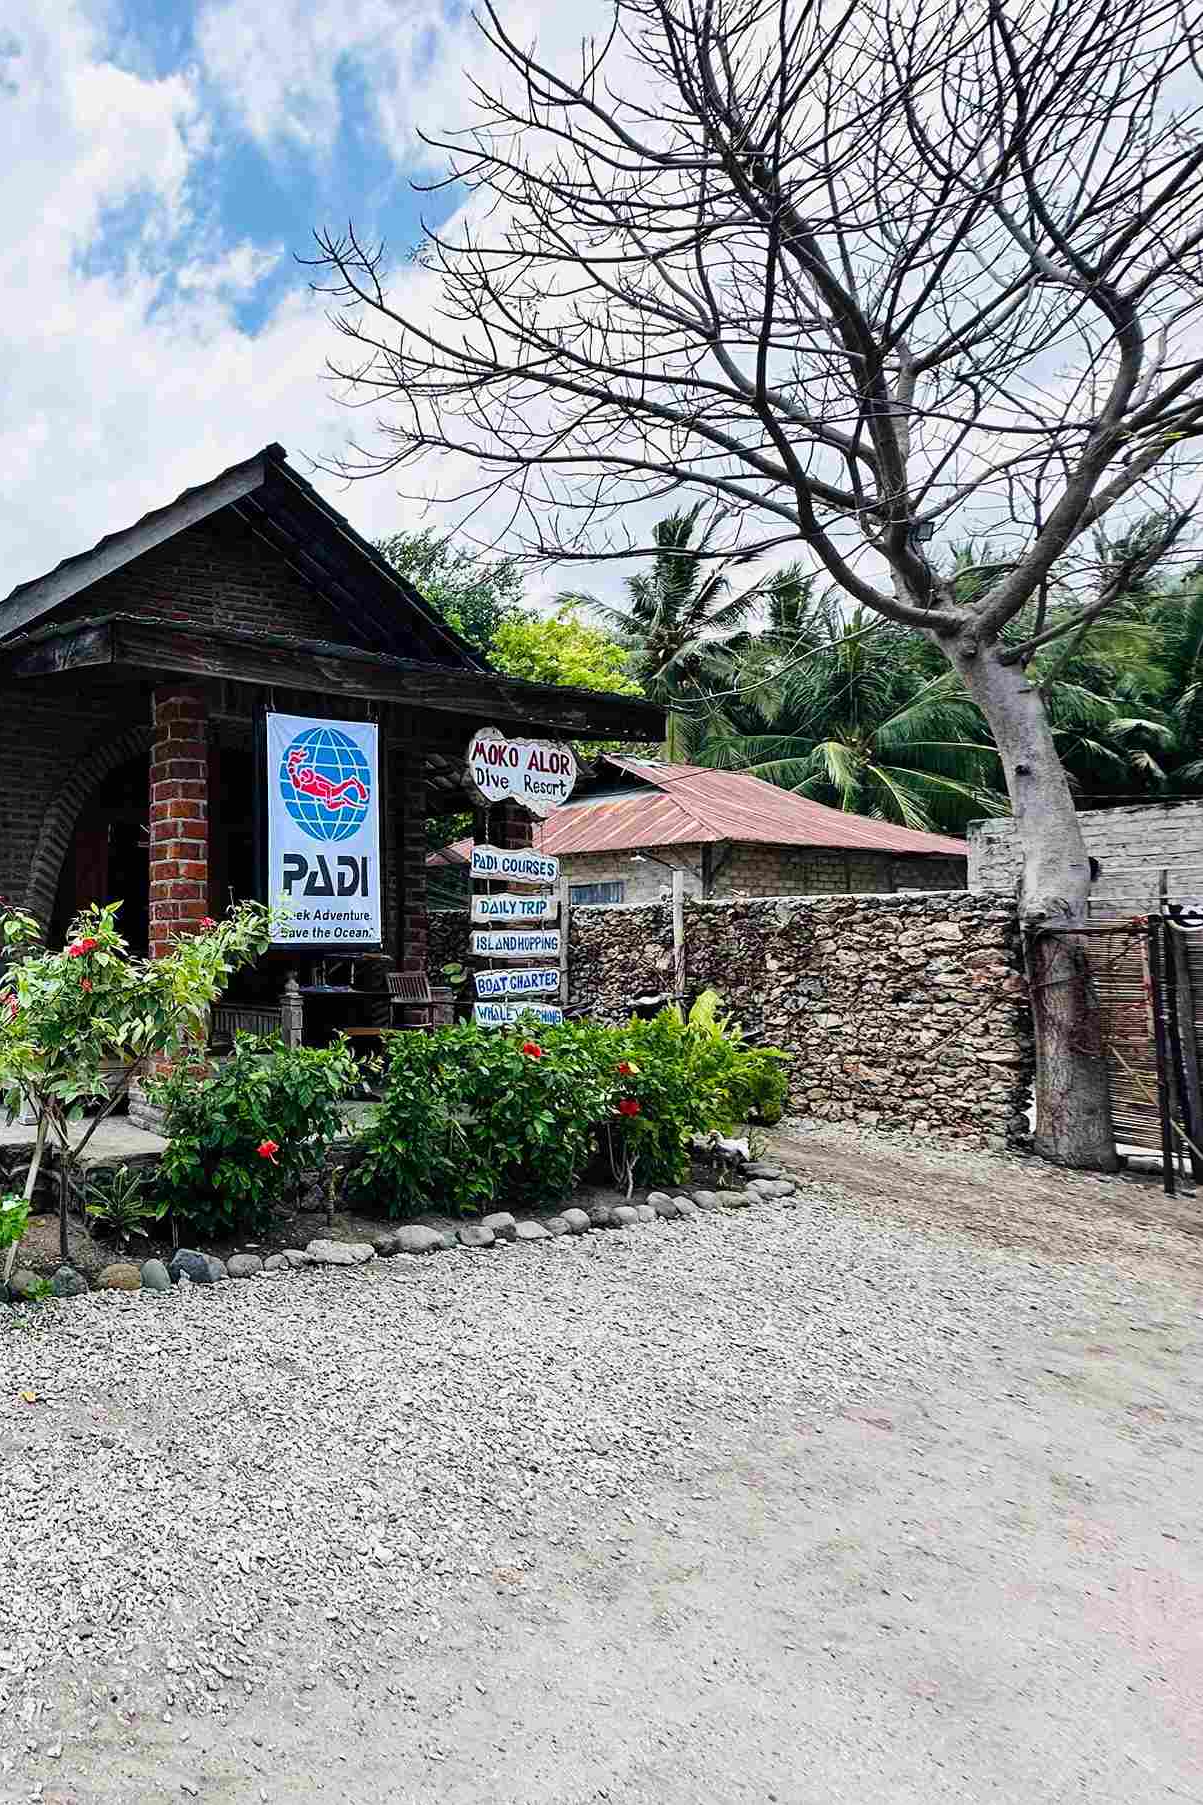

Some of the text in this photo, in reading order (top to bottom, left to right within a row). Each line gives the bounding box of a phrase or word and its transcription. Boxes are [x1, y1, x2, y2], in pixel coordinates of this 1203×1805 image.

[472, 741, 571, 776] MOKO ALOR
[524, 774, 567, 797] Resort
[283, 853, 369, 897] PADI
[473, 853, 555, 876] PADI COURSES
[480, 900, 547, 914] DAILY TRIP
[313, 927, 330, 938] the
[478, 972, 557, 993] BOAT CHARTER
[477, 1005, 513, 1021] WHALE
